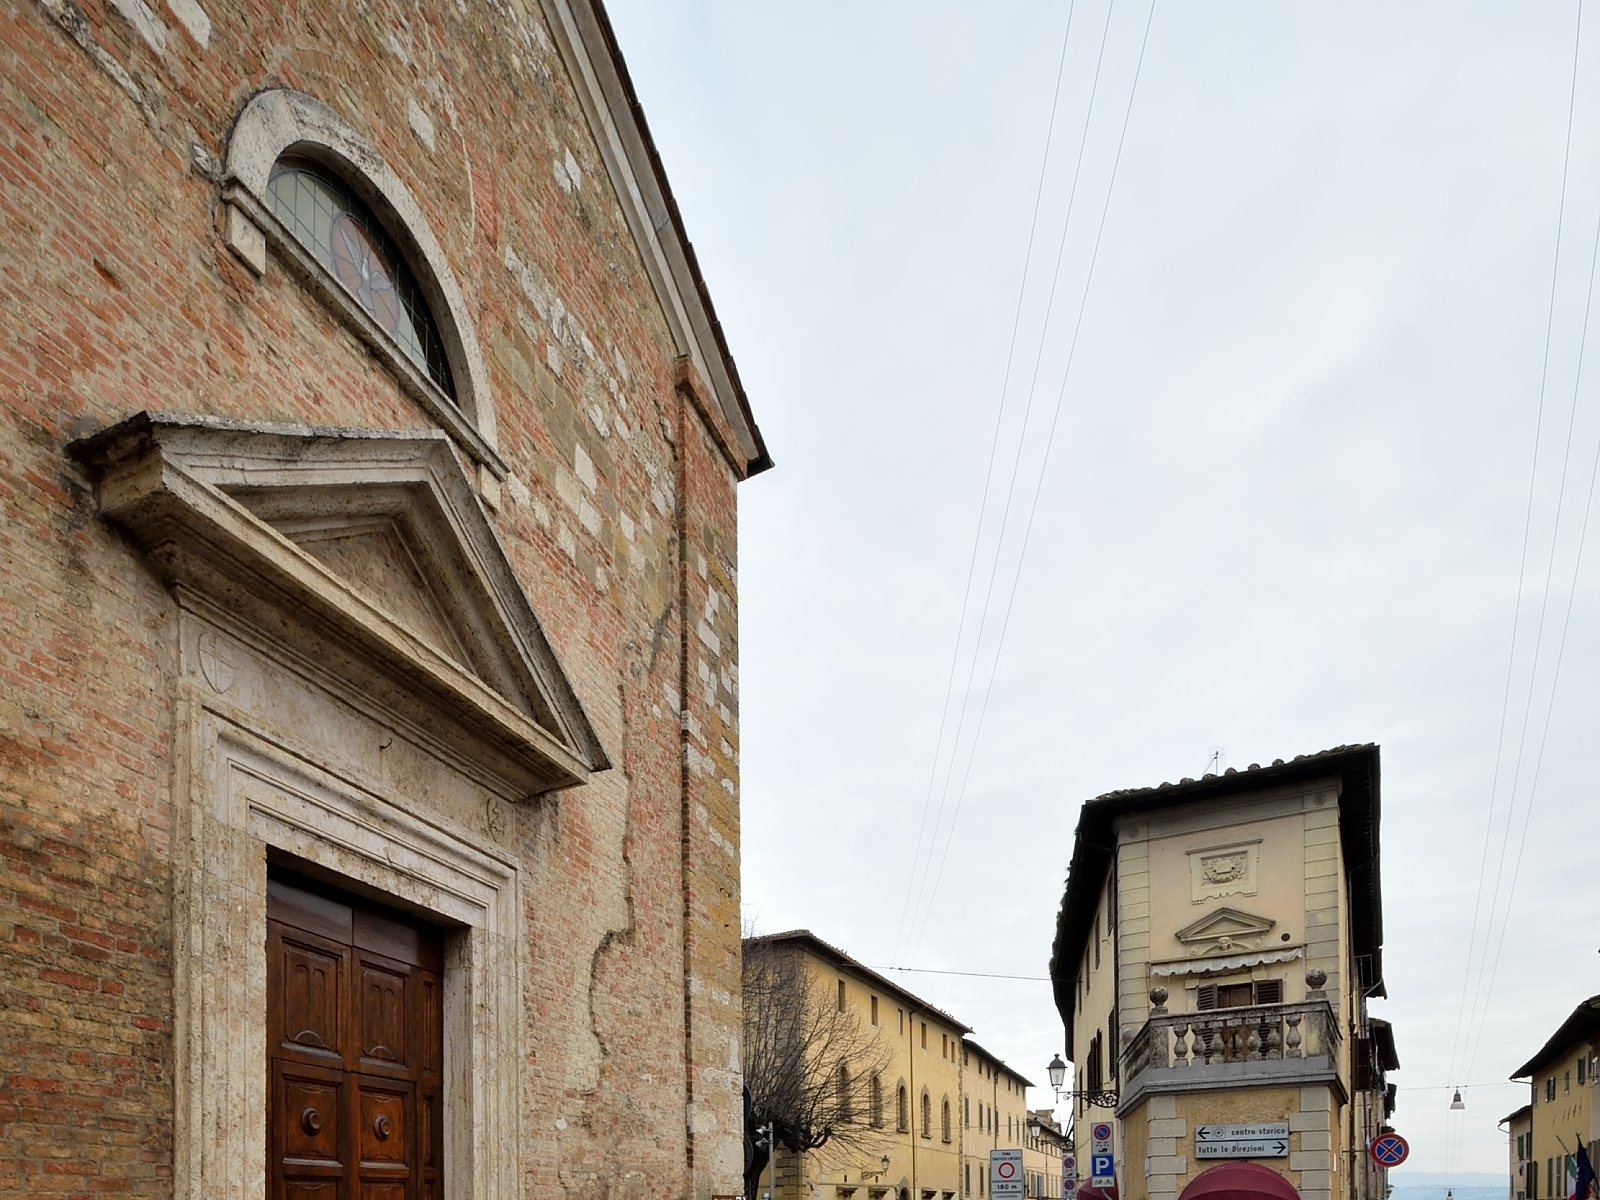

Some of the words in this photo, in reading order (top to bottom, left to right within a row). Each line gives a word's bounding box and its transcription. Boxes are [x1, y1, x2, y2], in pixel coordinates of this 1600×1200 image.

[1258, 1127, 1286, 1135] storico
[1221, 1145, 1228, 1153] le
[1232, 1145, 1265, 1153] Direzioni
[1095, 1157, 1110, 1174] P
